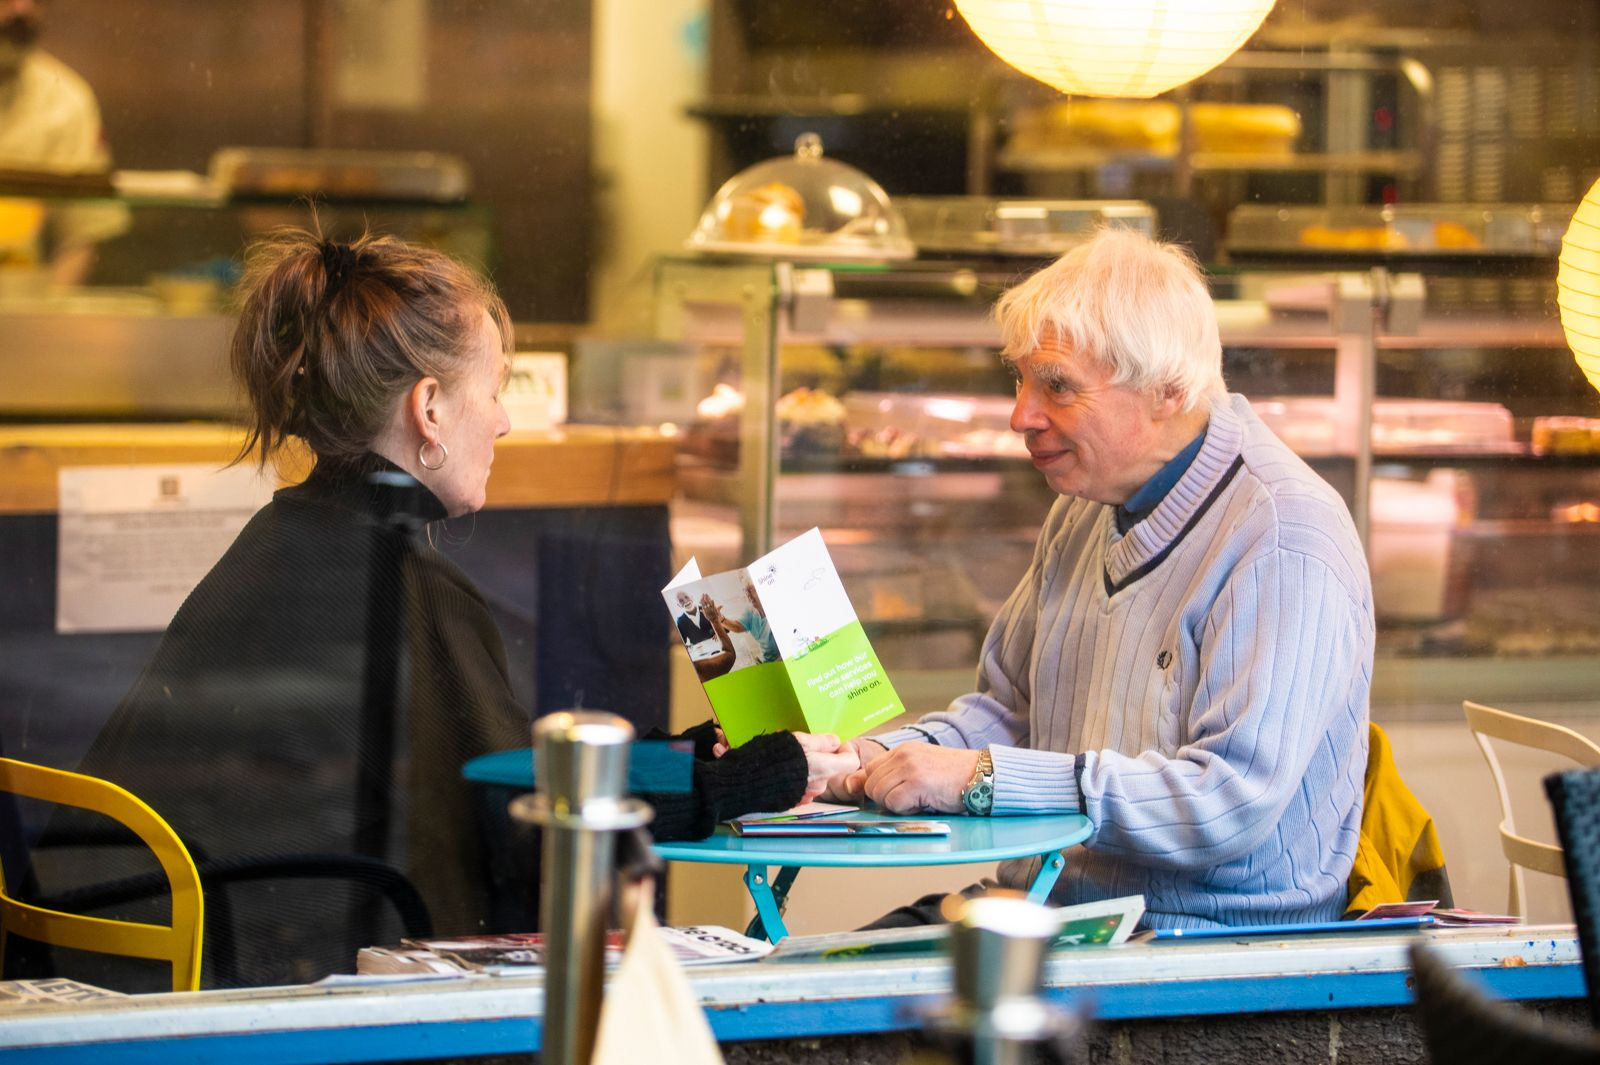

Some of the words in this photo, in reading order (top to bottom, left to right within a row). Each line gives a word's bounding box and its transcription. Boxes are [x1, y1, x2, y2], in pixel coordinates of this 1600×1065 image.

[807, 673, 822, 688] Find
[823, 667, 837, 679] out
[836, 659, 854, 672] how
[818, 677, 840, 692] home
[840, 661, 873, 680] services
[829, 686, 844, 698] can
[843, 677, 862, 691] help
[862, 669, 878, 682] you
[847, 686, 869, 700] shine
